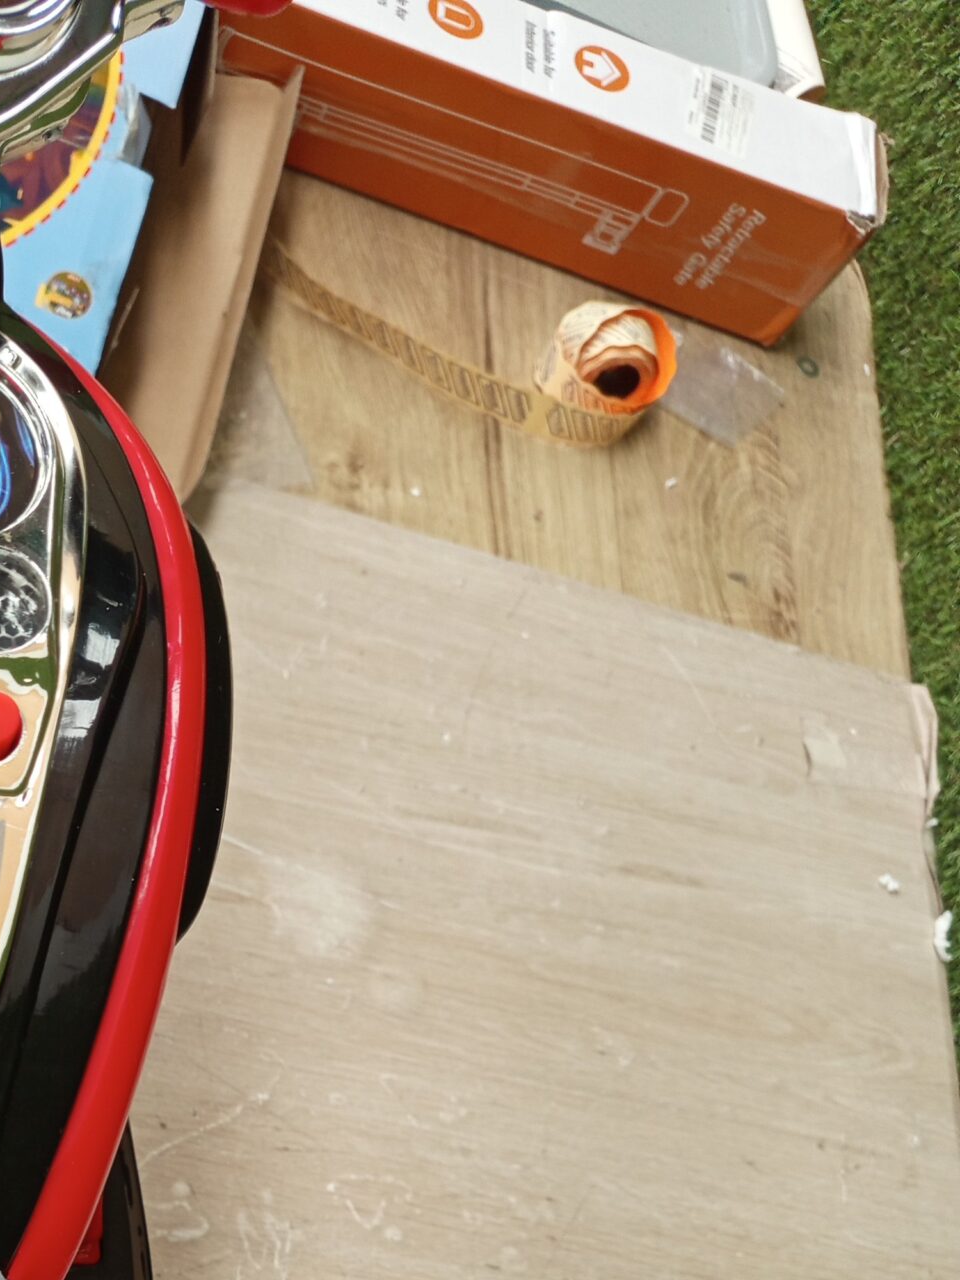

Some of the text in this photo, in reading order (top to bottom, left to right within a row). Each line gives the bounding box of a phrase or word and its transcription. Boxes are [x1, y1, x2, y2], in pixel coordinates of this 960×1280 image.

[673, 202, 746, 286] Safety Gate
[694, 208, 767, 289] Retractable
